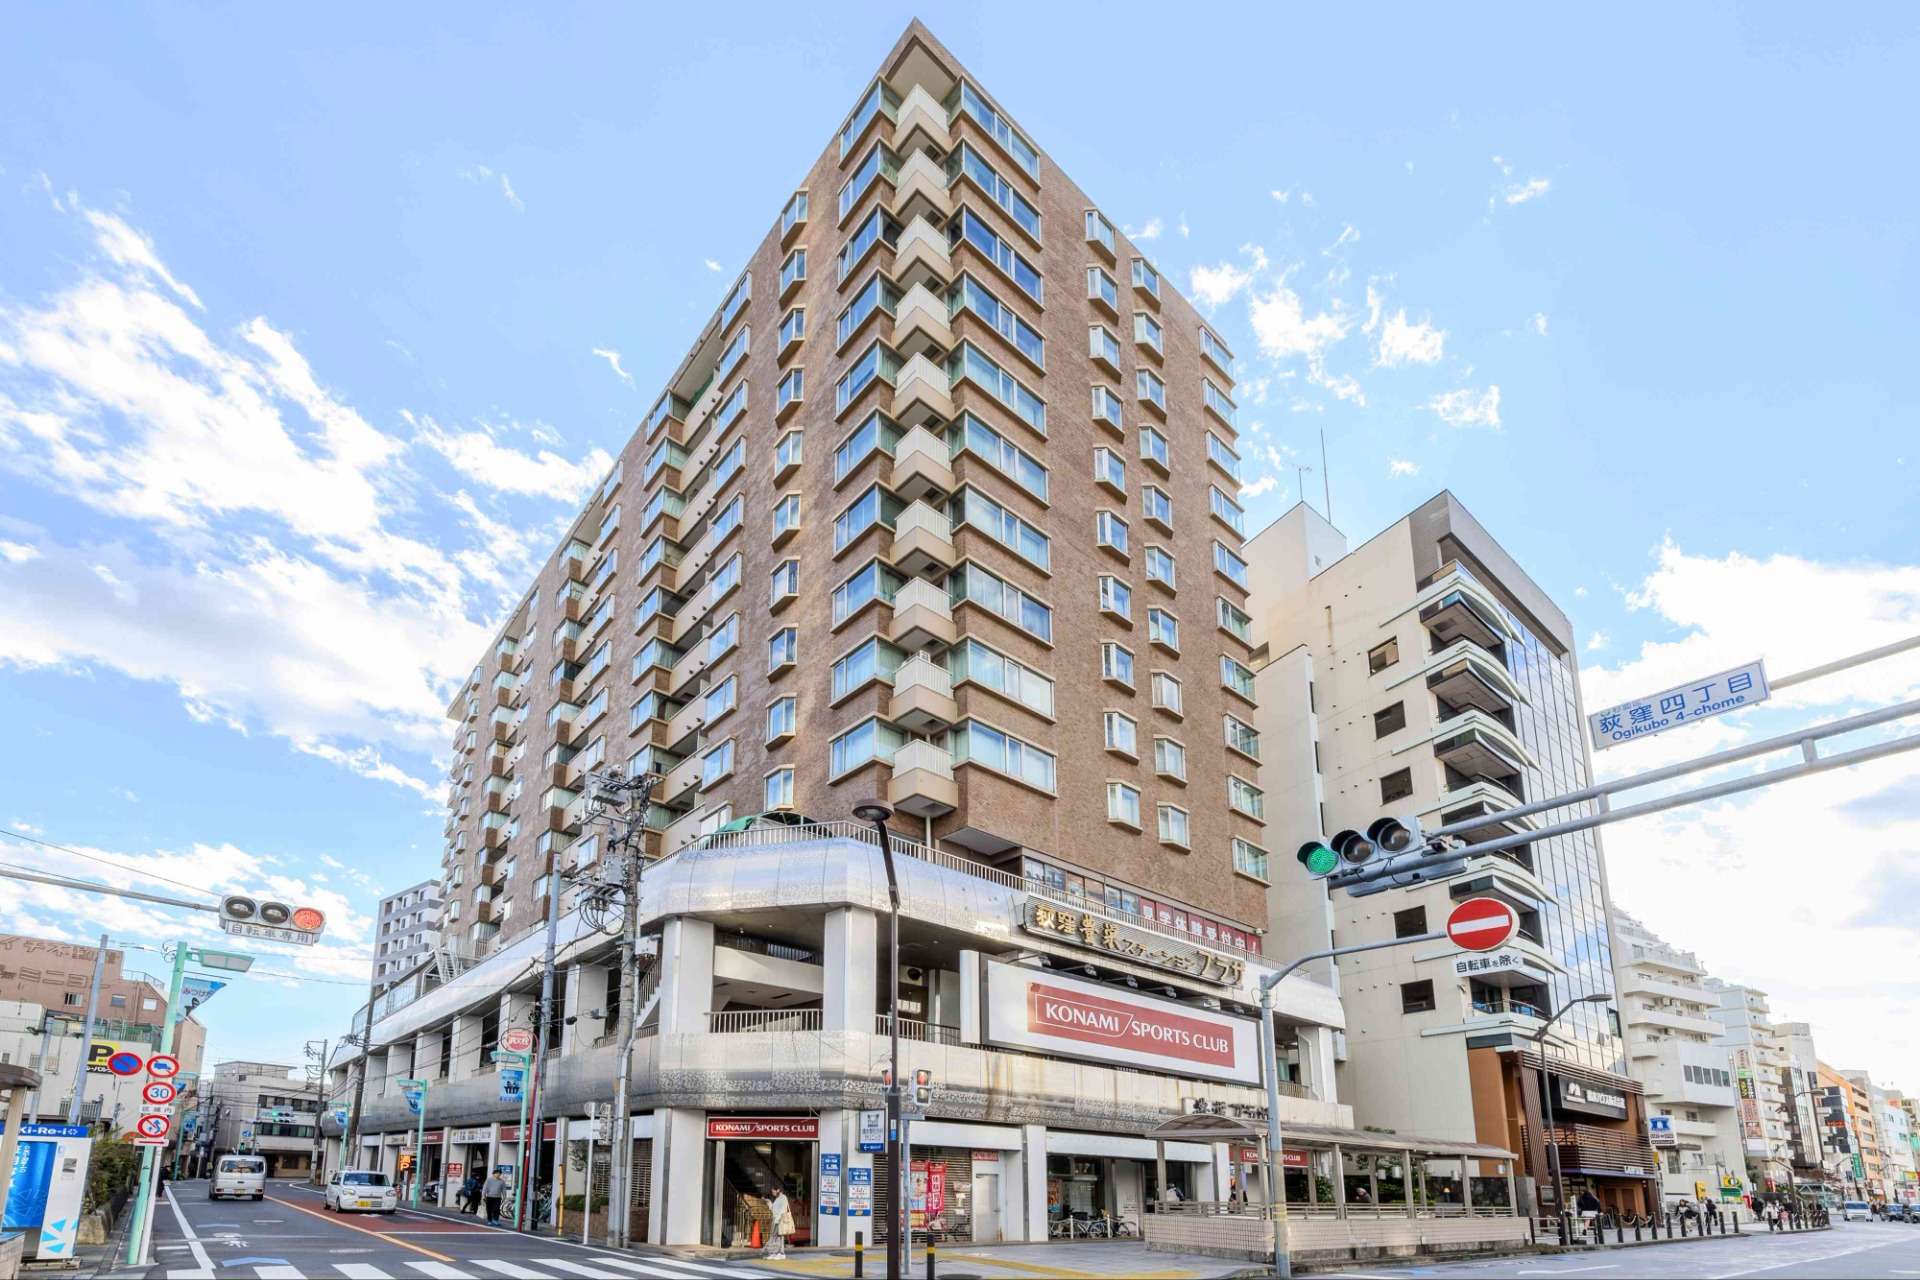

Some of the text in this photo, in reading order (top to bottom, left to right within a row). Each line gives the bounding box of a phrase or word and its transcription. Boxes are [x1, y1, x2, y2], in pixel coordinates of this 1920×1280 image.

[1599, 672, 1753, 734] 荻窪四丁目
[1612, 717, 1670, 741] Ogikubo
[1675, 694, 1745, 721] 4-chome
[1456, 954, 1520, 973] 自転車を除く
[1045, 1002, 1229, 1053] KONAMI SPORTS CLUB
[88, 1044, 115, 1062] P
[150, 1087, 170, 1099] 30
[715, 1124, 815, 1132] KONAMI SPORTS CLUB
